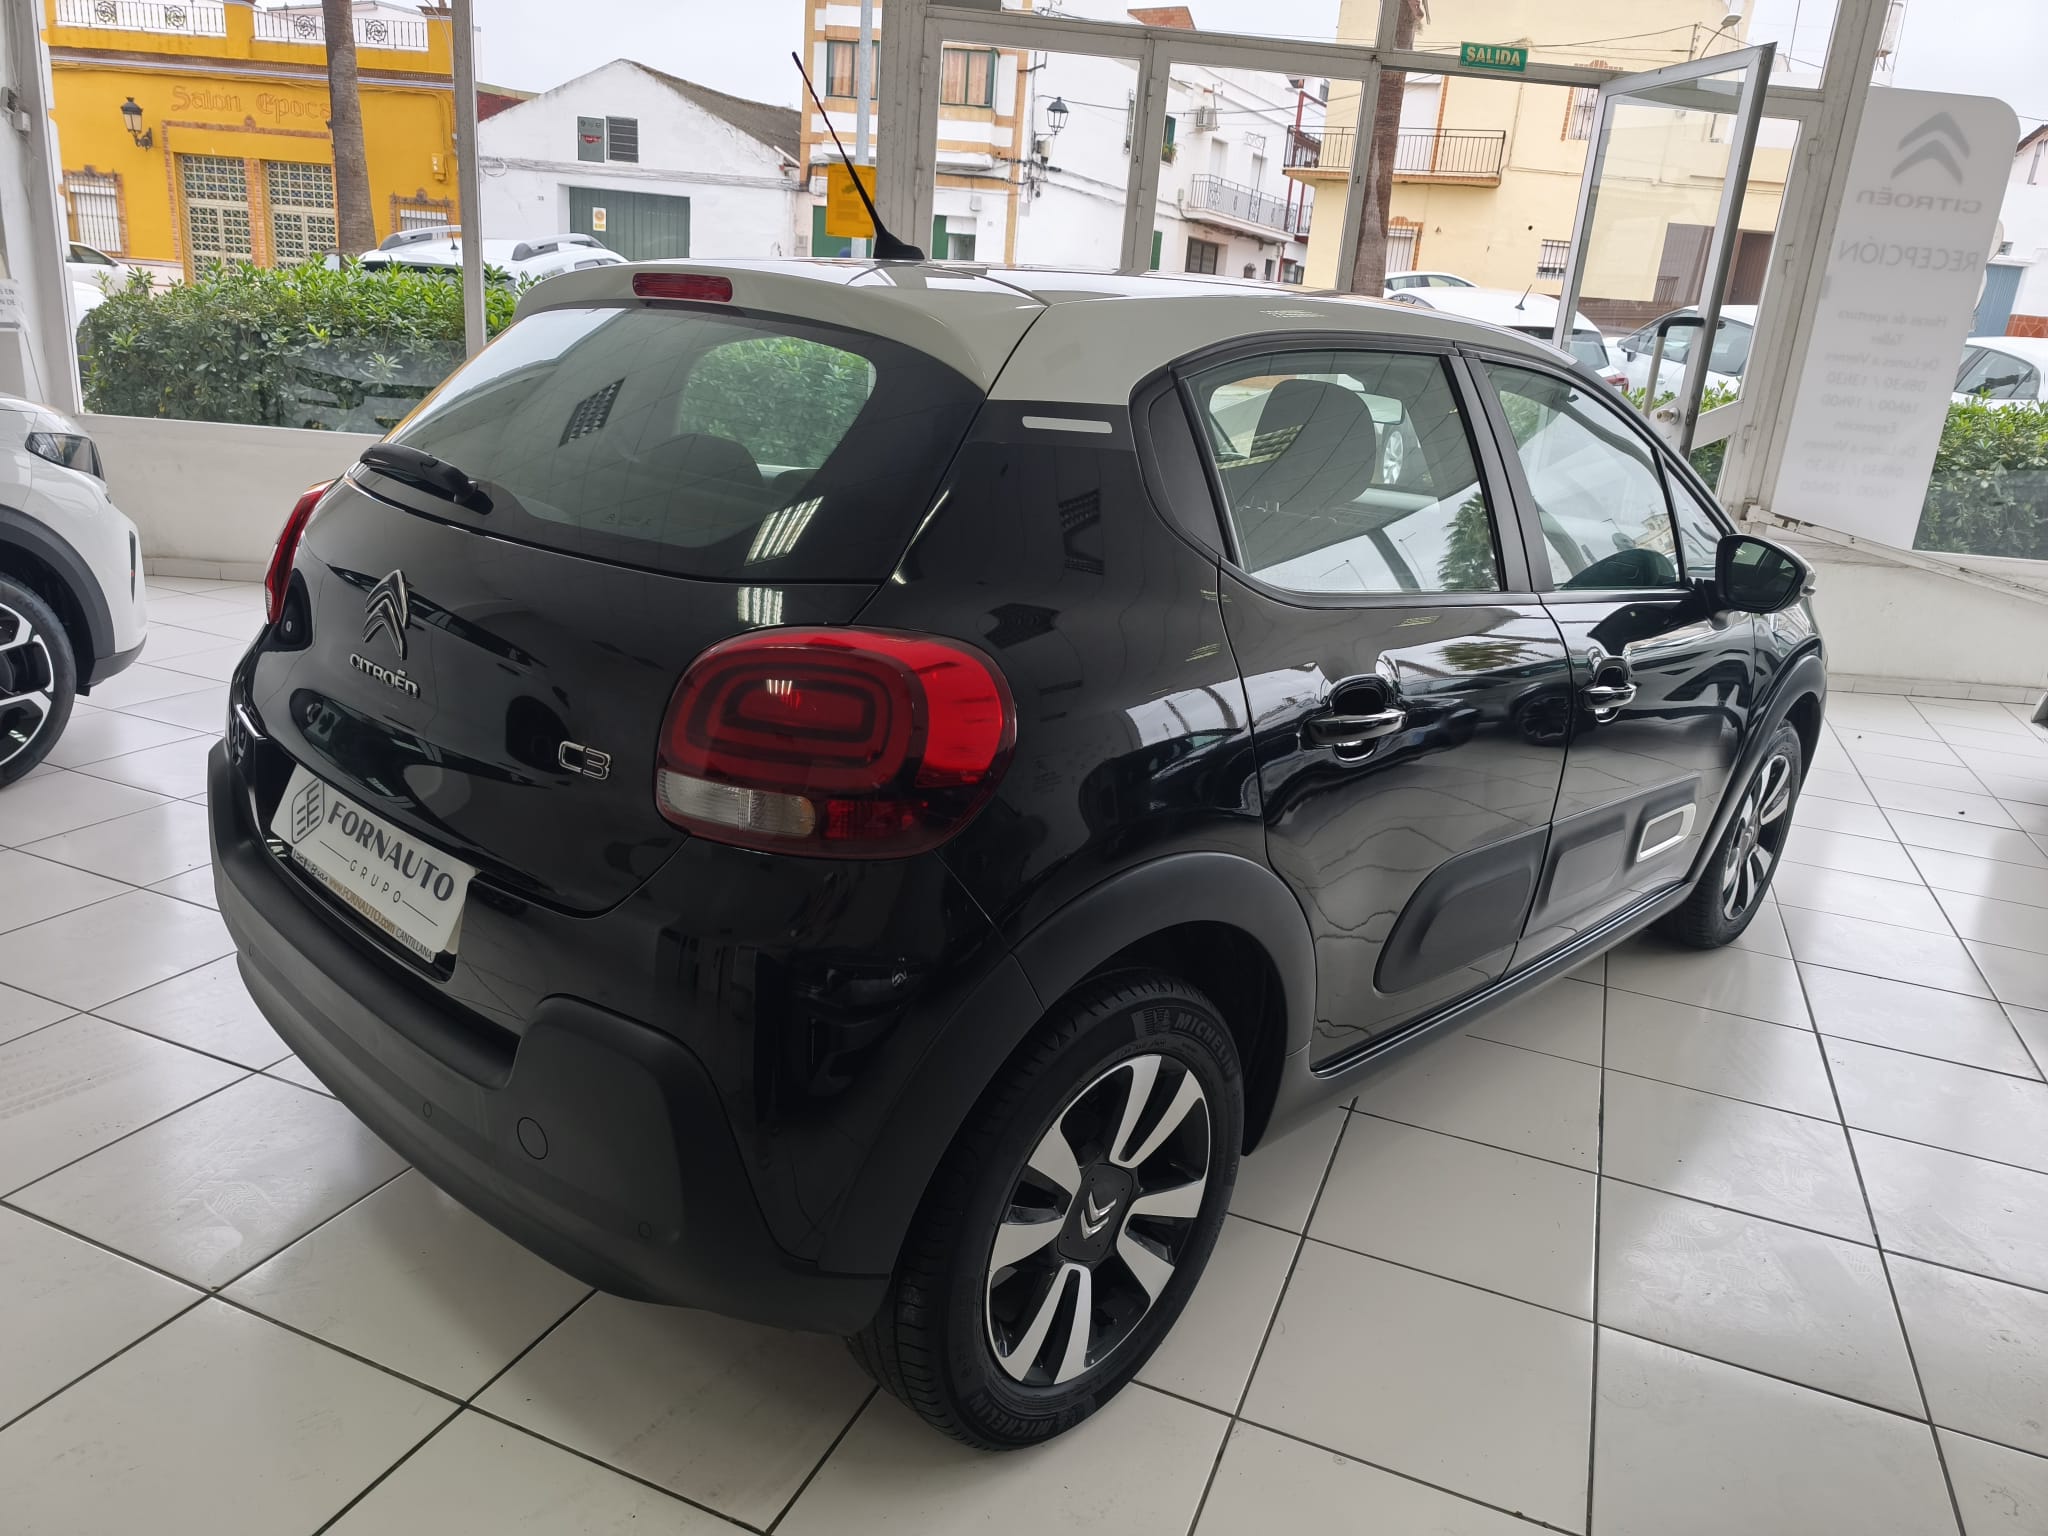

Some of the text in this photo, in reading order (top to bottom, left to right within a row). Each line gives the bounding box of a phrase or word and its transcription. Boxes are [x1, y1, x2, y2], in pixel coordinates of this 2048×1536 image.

[1466, 46, 1521, 67] SALIDA
[558, 740, 611, 780] C3
[327, 800, 455, 902] FORNAUTO
[350, 860, 402, 903] GRUPO
[1175, 1012, 1237, 1075] MICHELIN
[970, 1392, 1053, 1438] MICHELIN
